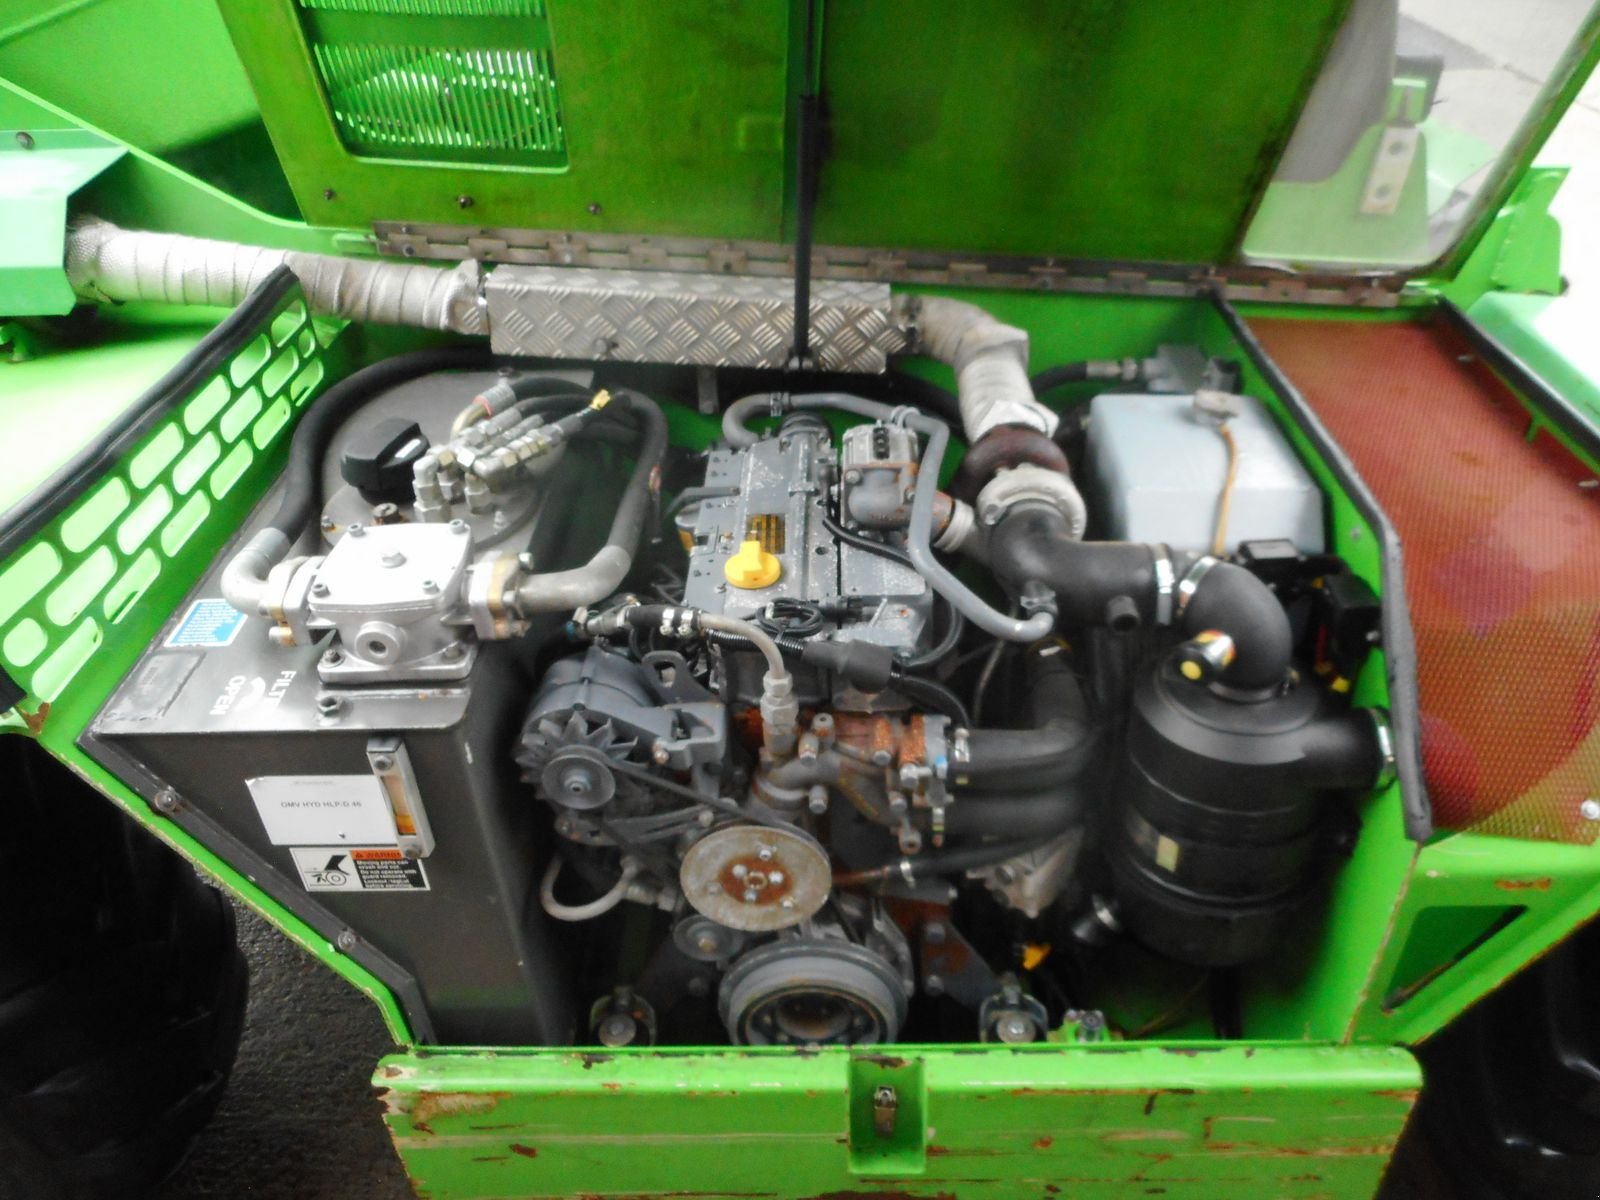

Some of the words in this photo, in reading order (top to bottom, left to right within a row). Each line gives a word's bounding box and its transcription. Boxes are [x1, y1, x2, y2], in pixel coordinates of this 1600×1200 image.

[209, 676, 246, 715] OPEN
[280, 800, 300, 808] OMV
[302, 800, 320, 808] HYD
